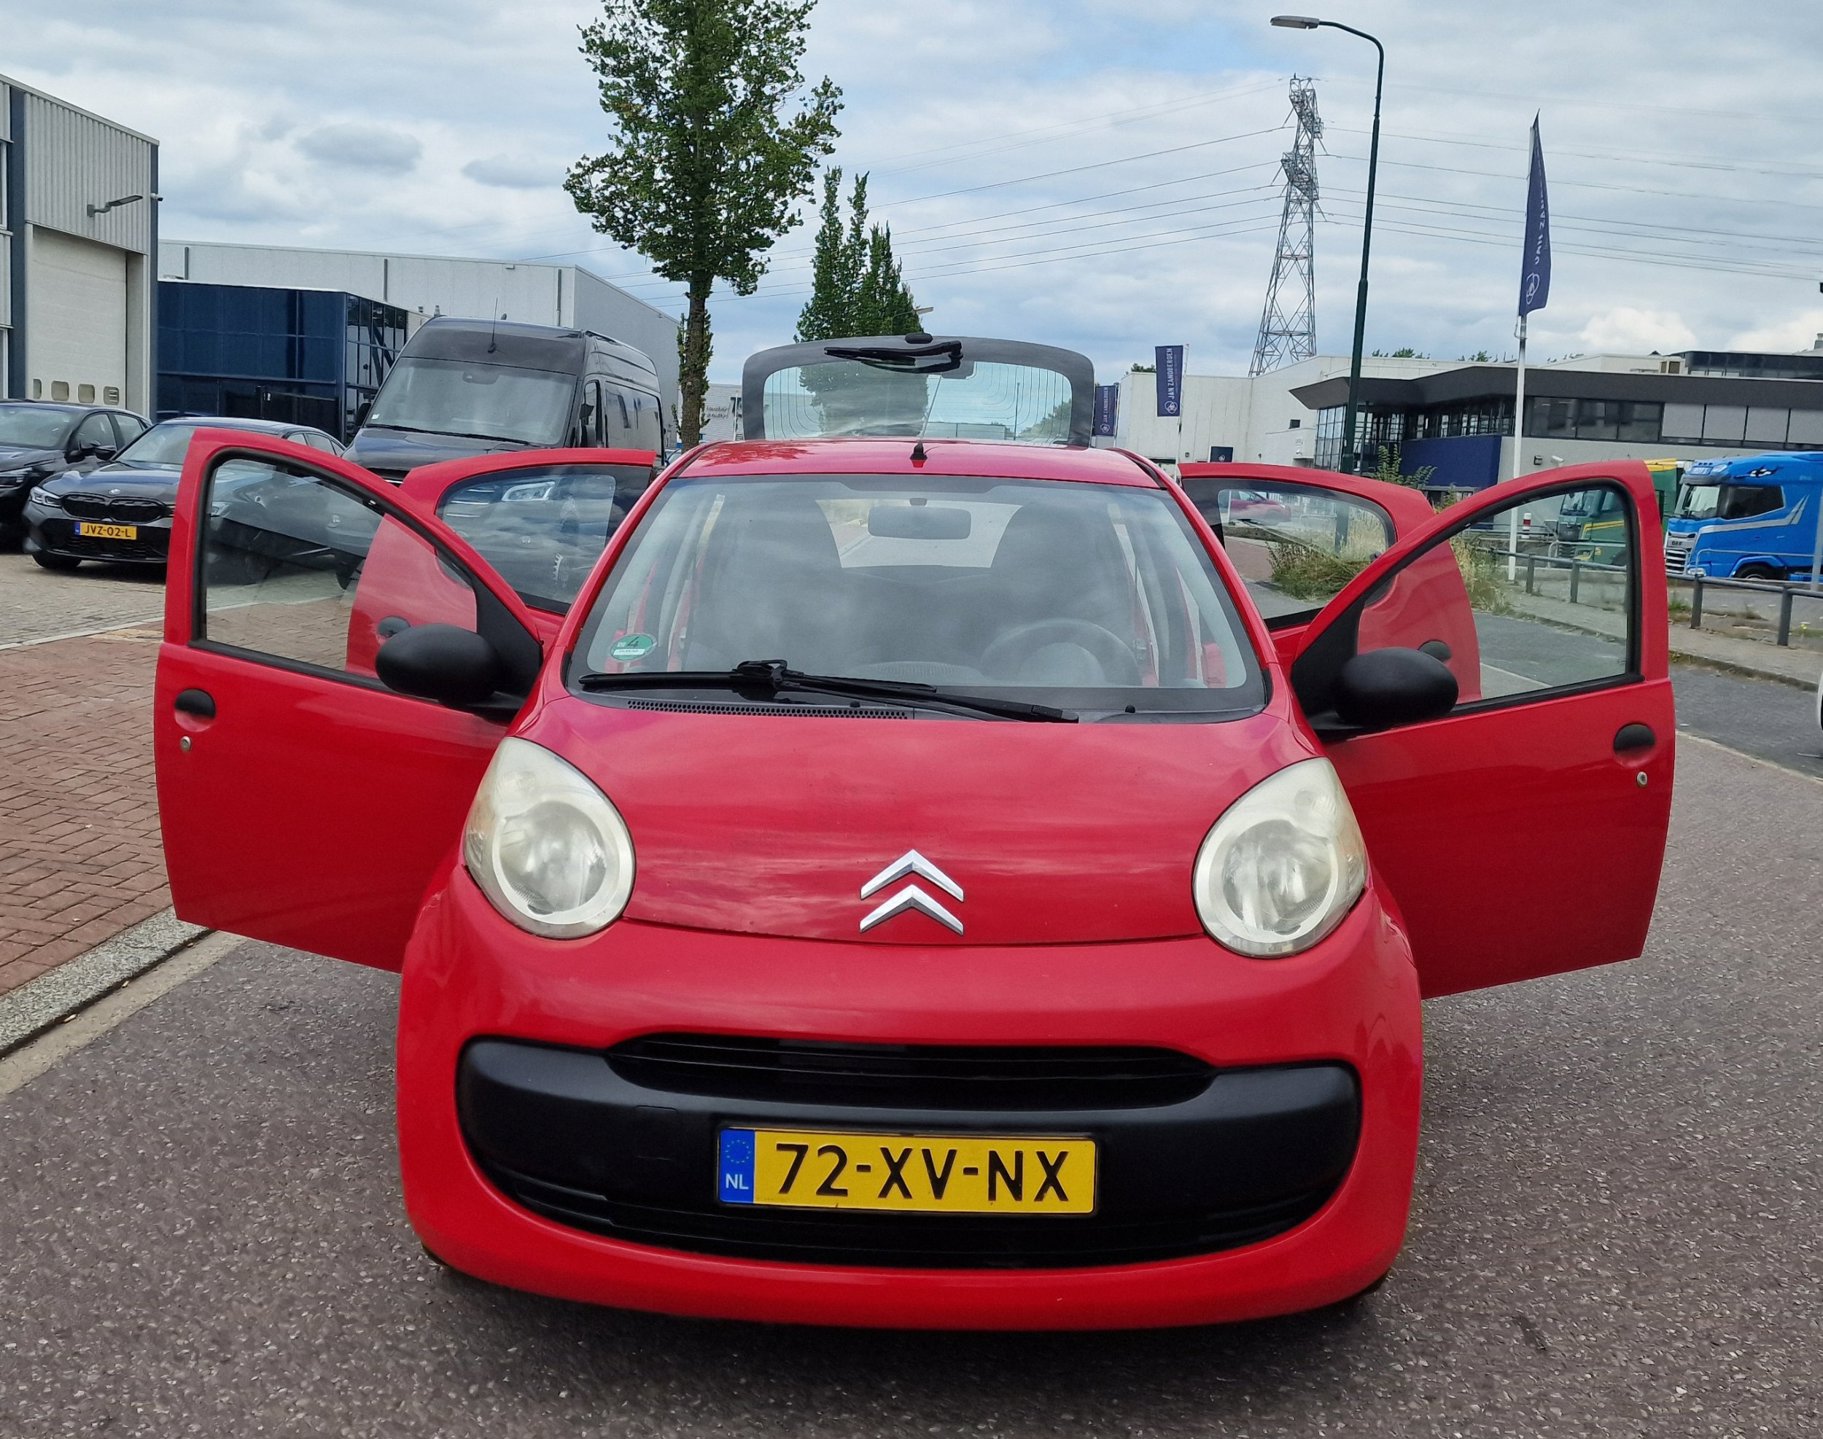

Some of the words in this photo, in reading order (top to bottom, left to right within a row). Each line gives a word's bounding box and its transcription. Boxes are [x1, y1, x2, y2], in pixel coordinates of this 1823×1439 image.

[1167, 387, 1175, 399] JAN
[85, 525, 131, 537] JVZ-02-L
[775, 1142, 1070, 1202] 72-XV-NX
[725, 1173, 749, 1190] NL
